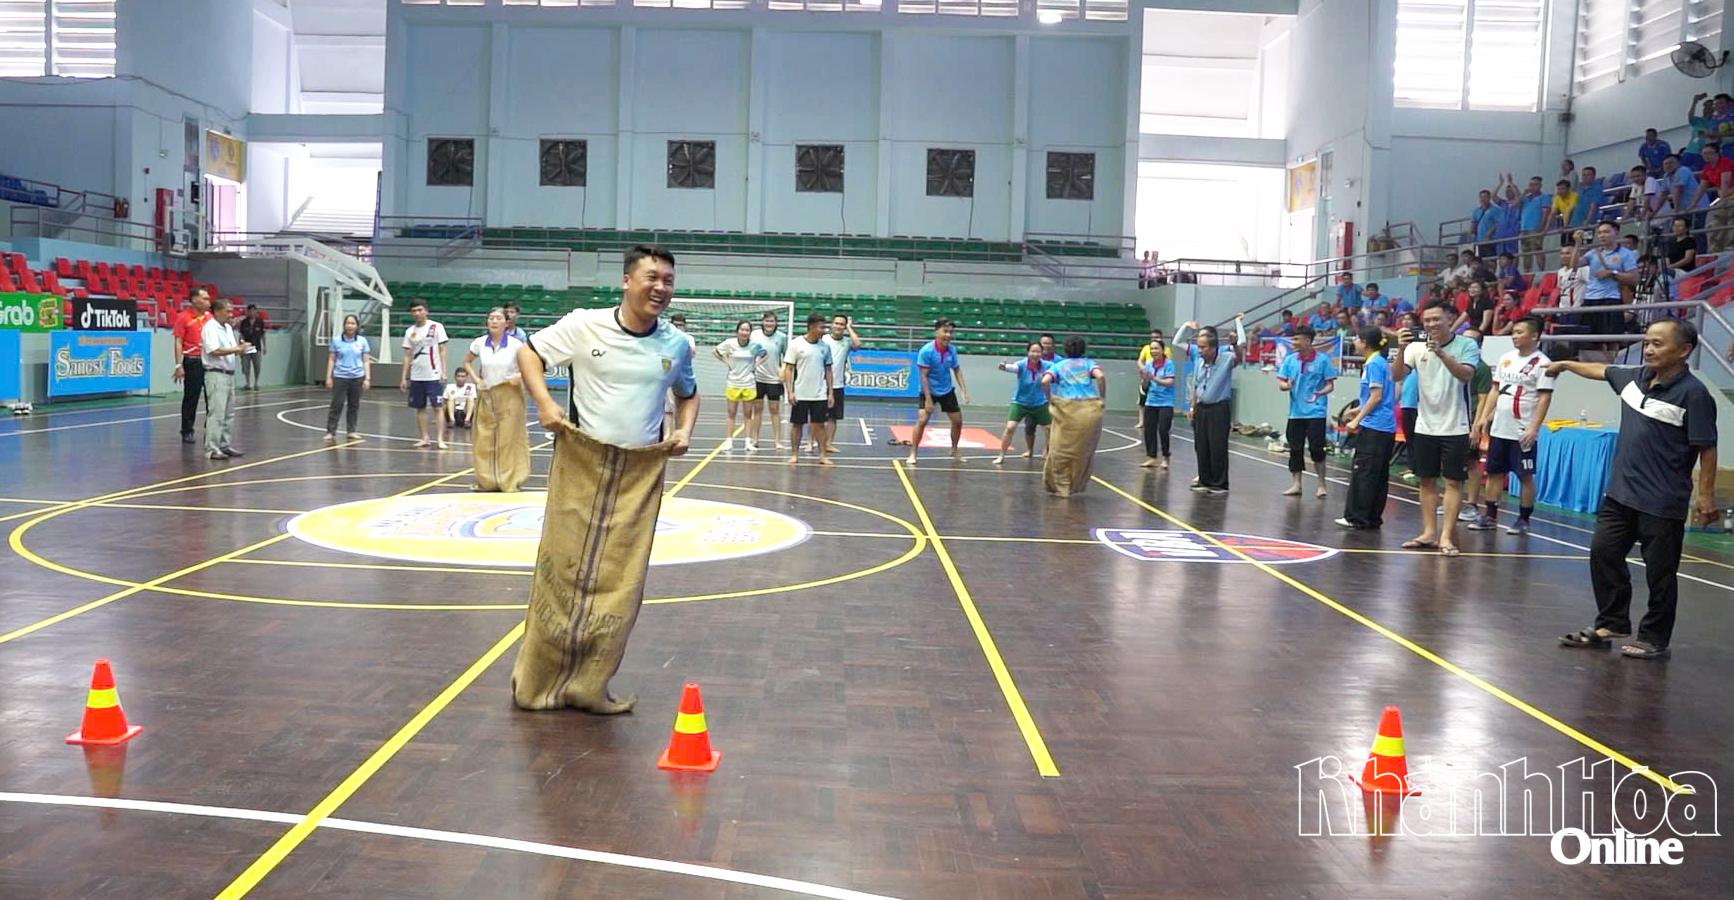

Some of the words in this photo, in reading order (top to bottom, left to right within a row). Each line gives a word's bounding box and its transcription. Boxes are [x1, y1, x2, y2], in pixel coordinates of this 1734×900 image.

[0, 300, 35, 326] rab
[94, 308, 131, 328] TikTok
[108, 348, 144, 377] Foods
[845, 368, 910, 389] anest
[1521, 459, 1534, 470] 10
